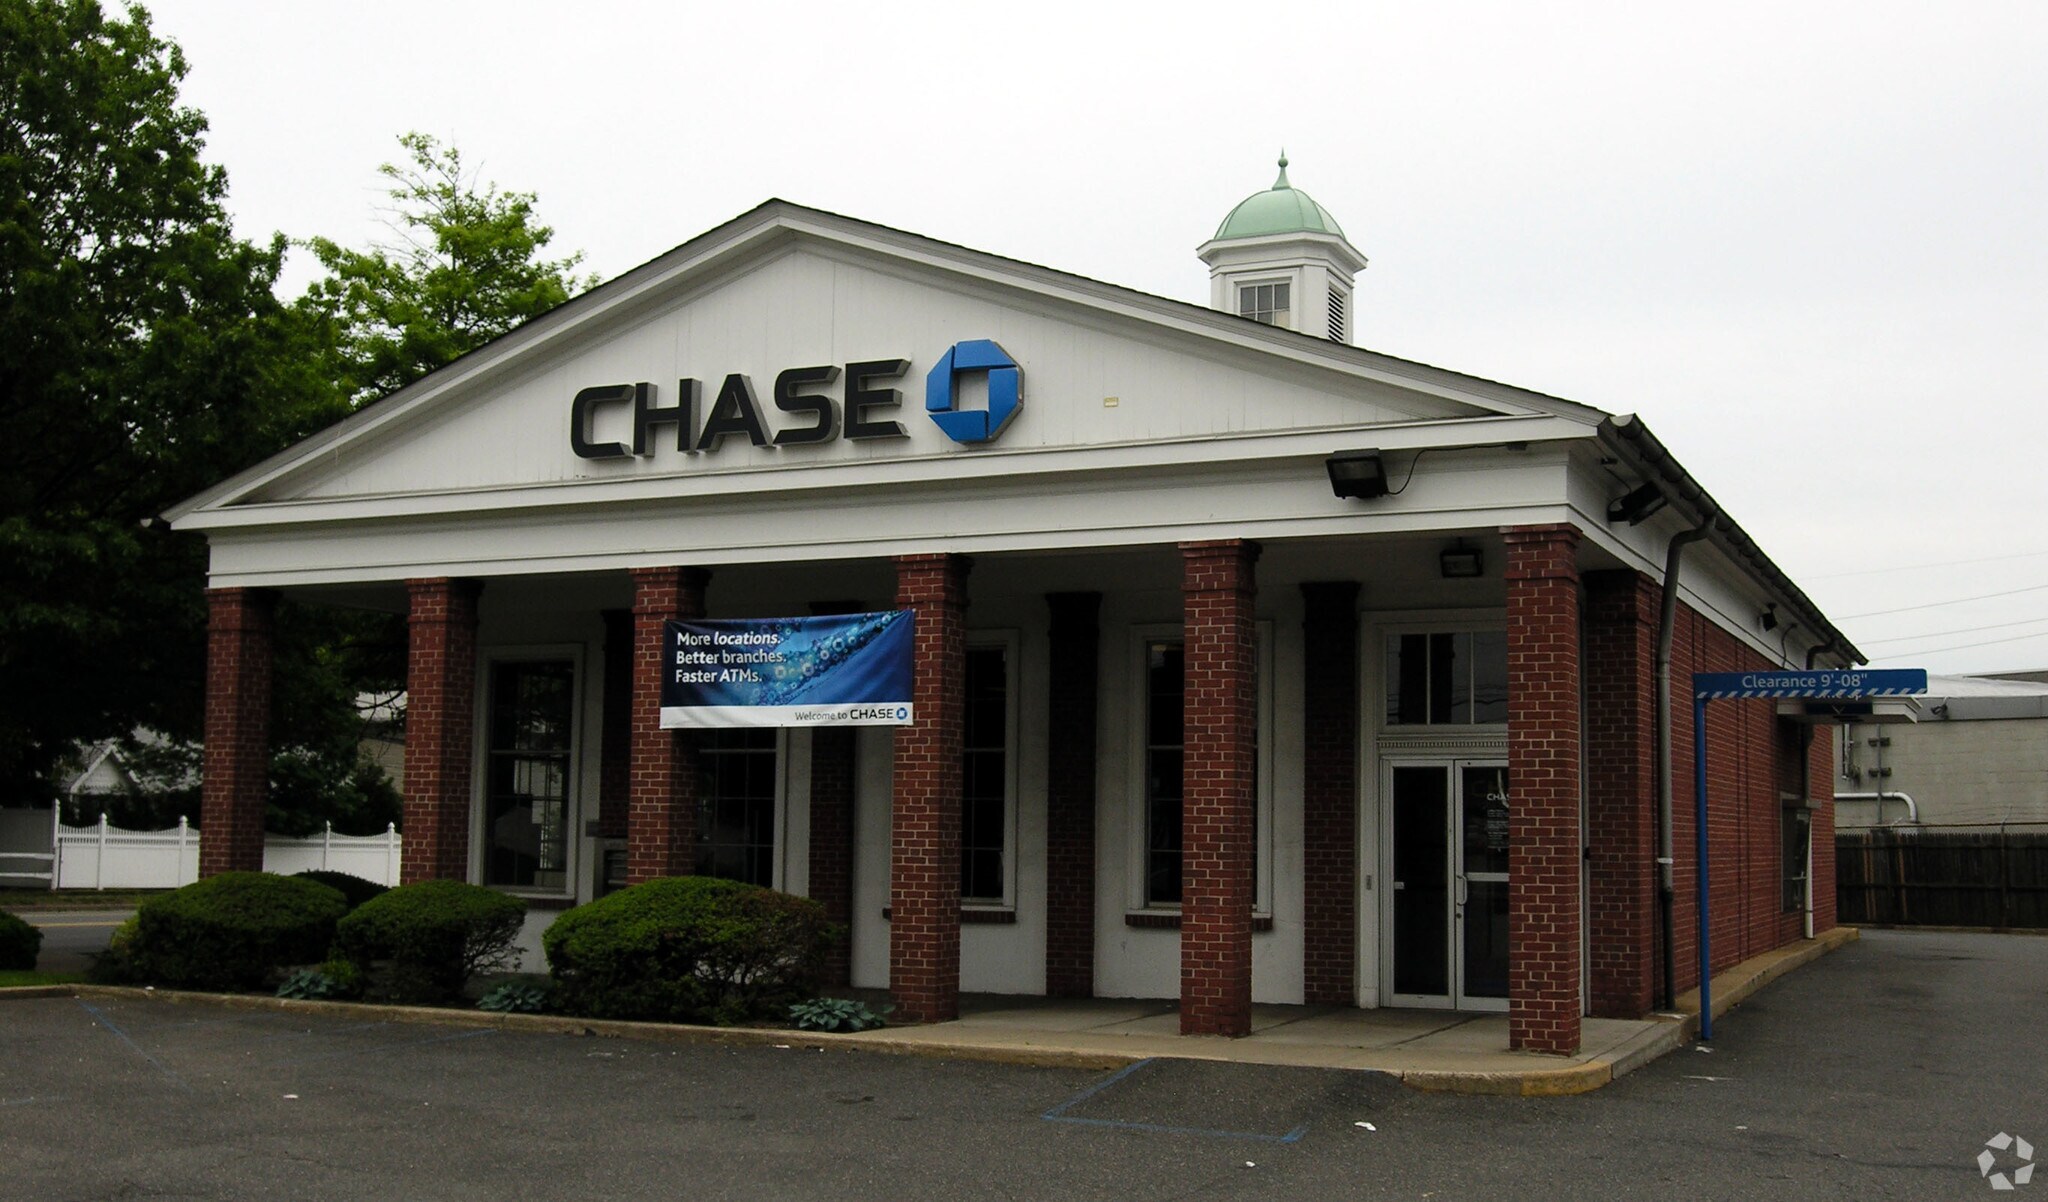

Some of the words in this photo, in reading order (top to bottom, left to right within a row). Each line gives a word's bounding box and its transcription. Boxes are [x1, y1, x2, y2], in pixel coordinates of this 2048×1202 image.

[571, 358, 911, 459] CHASE
[677, 632, 711, 646] More
[713, 630, 781, 645] locations.
[676, 651, 719, 664] Better
[722, 650, 787, 663] branches.
[675, 669, 717, 683] Faster
[719, 668, 763, 682] ATMs.
[1742, 675, 1816, 689] Clearance
[795, 711, 836, 721] Welcome
[837, 710, 848, 720] to
[850, 708, 894, 720] CHASE
